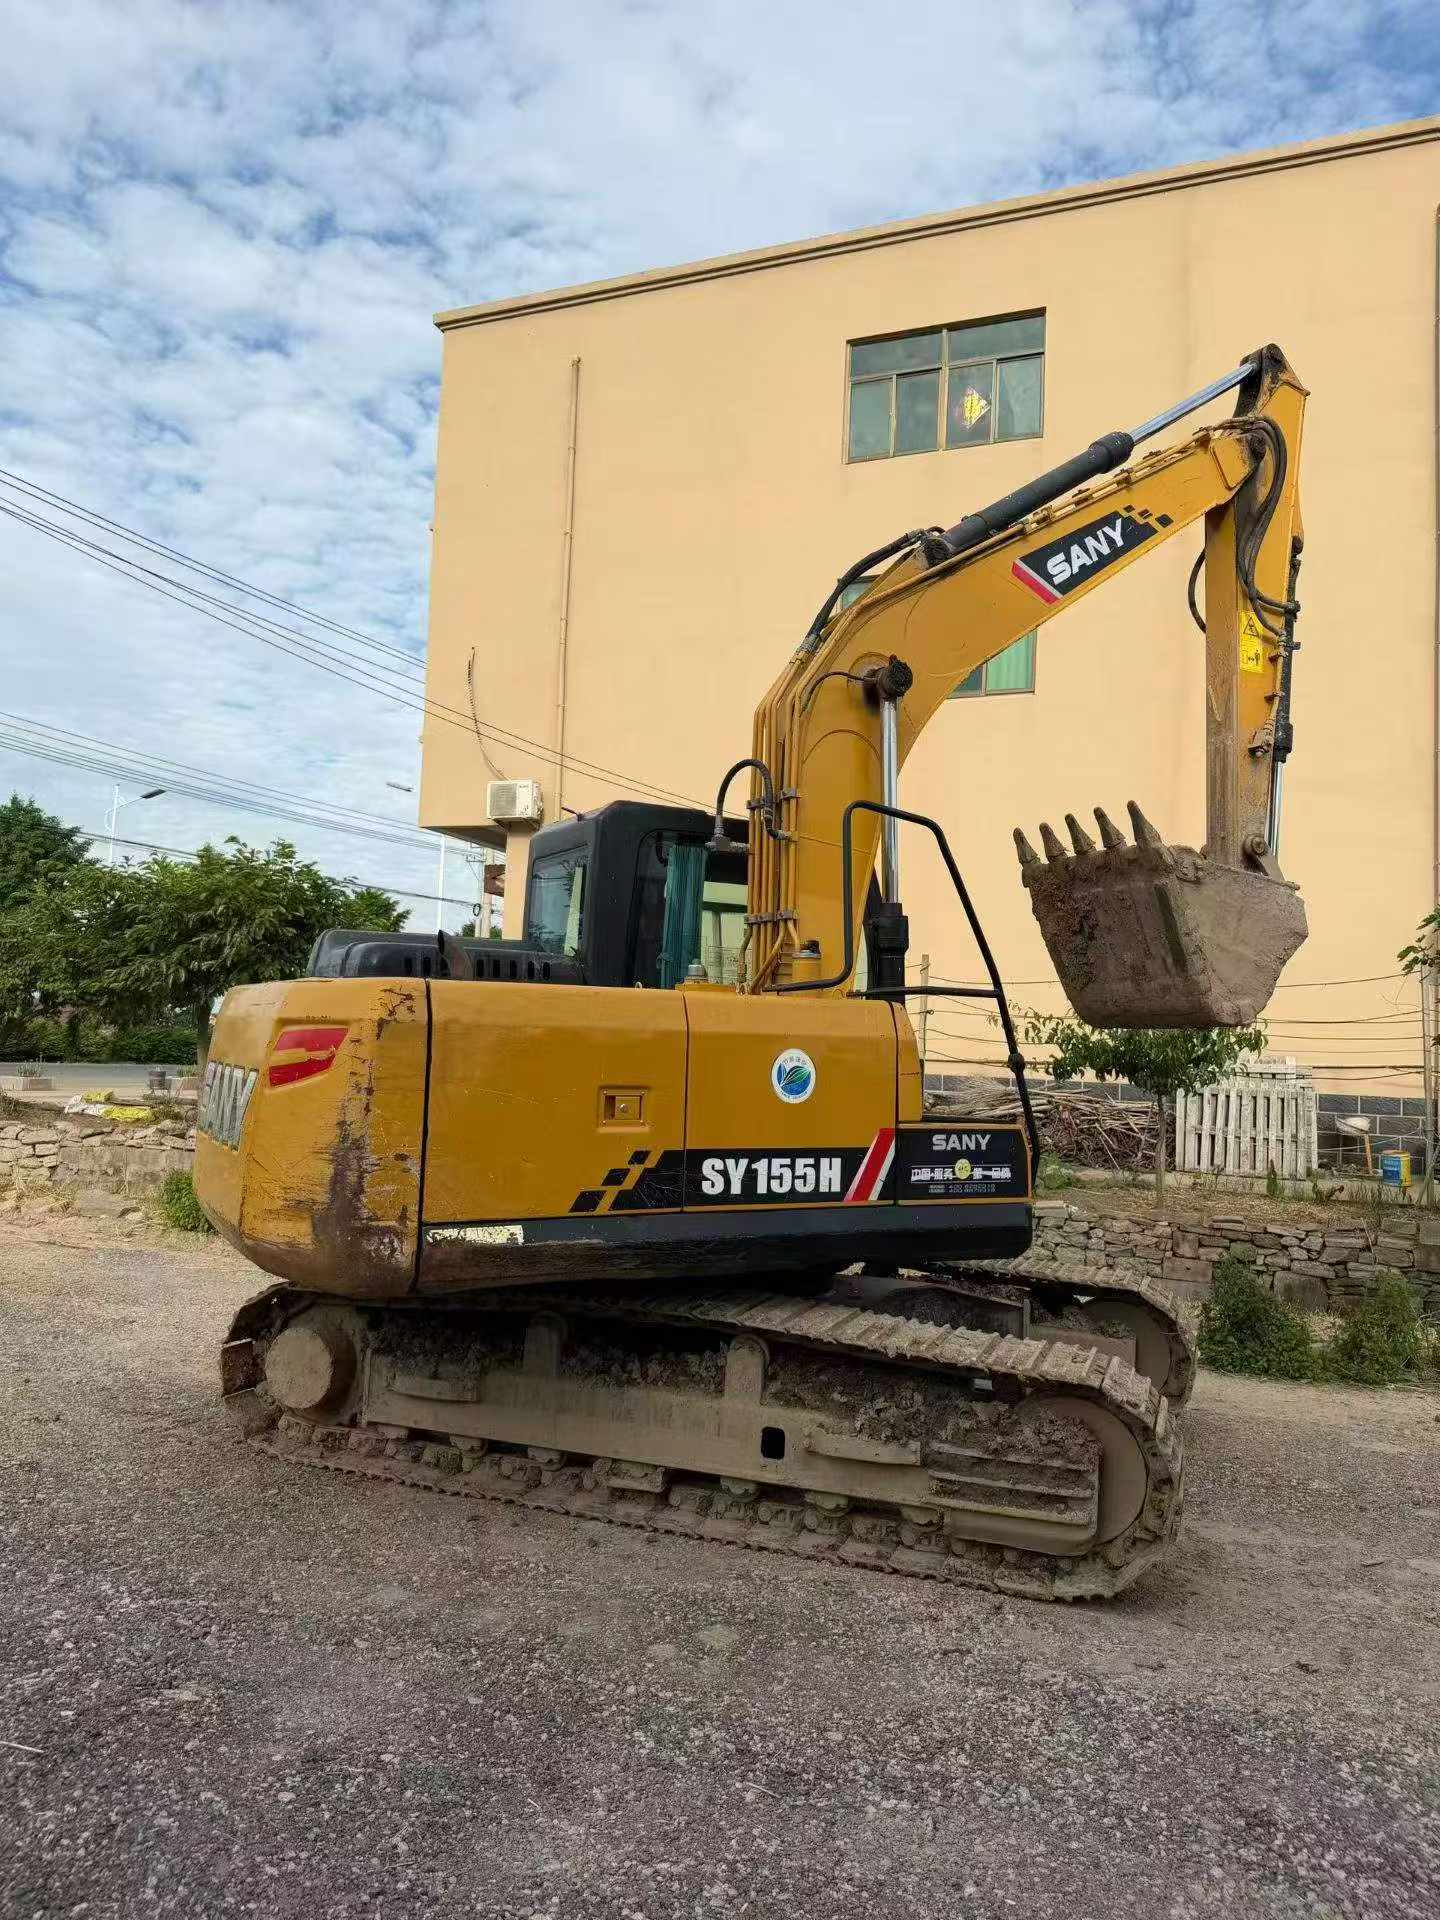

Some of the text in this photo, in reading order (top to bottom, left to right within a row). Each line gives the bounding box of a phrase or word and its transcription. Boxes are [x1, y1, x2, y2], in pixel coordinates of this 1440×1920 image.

[1046, 518, 1125, 586] SANY
[932, 1134, 991, 1151] SANY
[701, 1157, 842, 1195] SY155H
